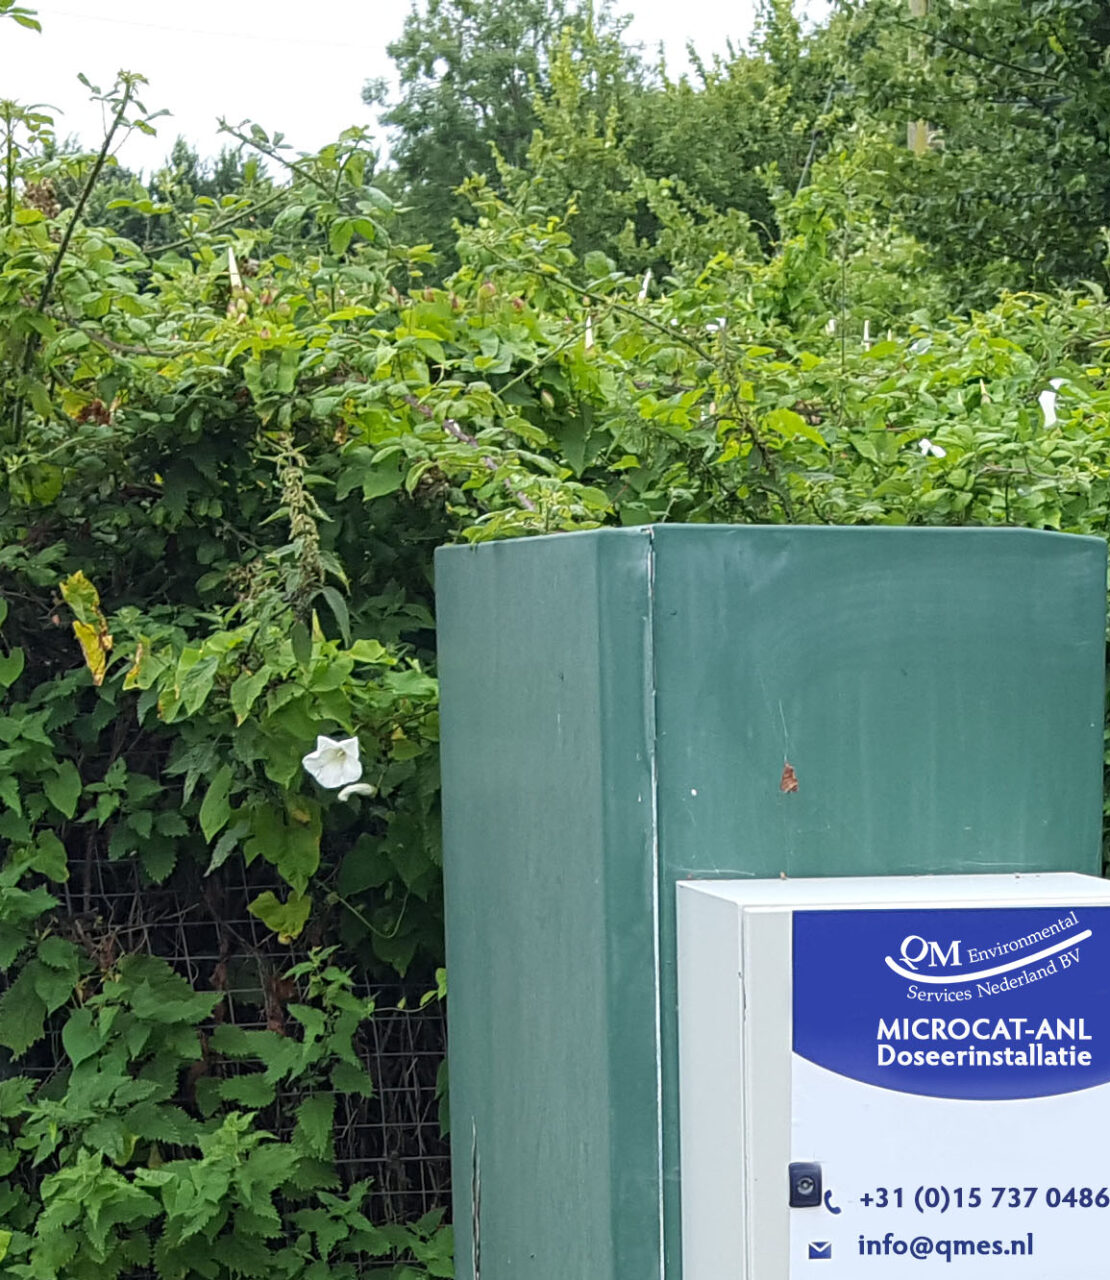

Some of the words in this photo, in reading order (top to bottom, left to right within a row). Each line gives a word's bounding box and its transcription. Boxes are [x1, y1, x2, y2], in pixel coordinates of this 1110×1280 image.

[899, 934, 962, 970] QM
[968, 911, 1080, 964] Environmental
[906, 985, 973, 1002] Services
[977, 961, 1058, 998] Nederland
[1058, 948, 1082, 970] BV
[877, 1018, 1092, 1041] MICROCAT-ANL
[877, 1044, 1092, 1067] Doseerinstallatie
[859, 1187, 904, 1208] +31
[914, 1185, 982, 1214] (0)15
[991, 1187, 1038, 1208] 737
[1045, 1187, 1110, 1208] 0486
[857, 1232, 1034, 1263] info@qmes.nl
